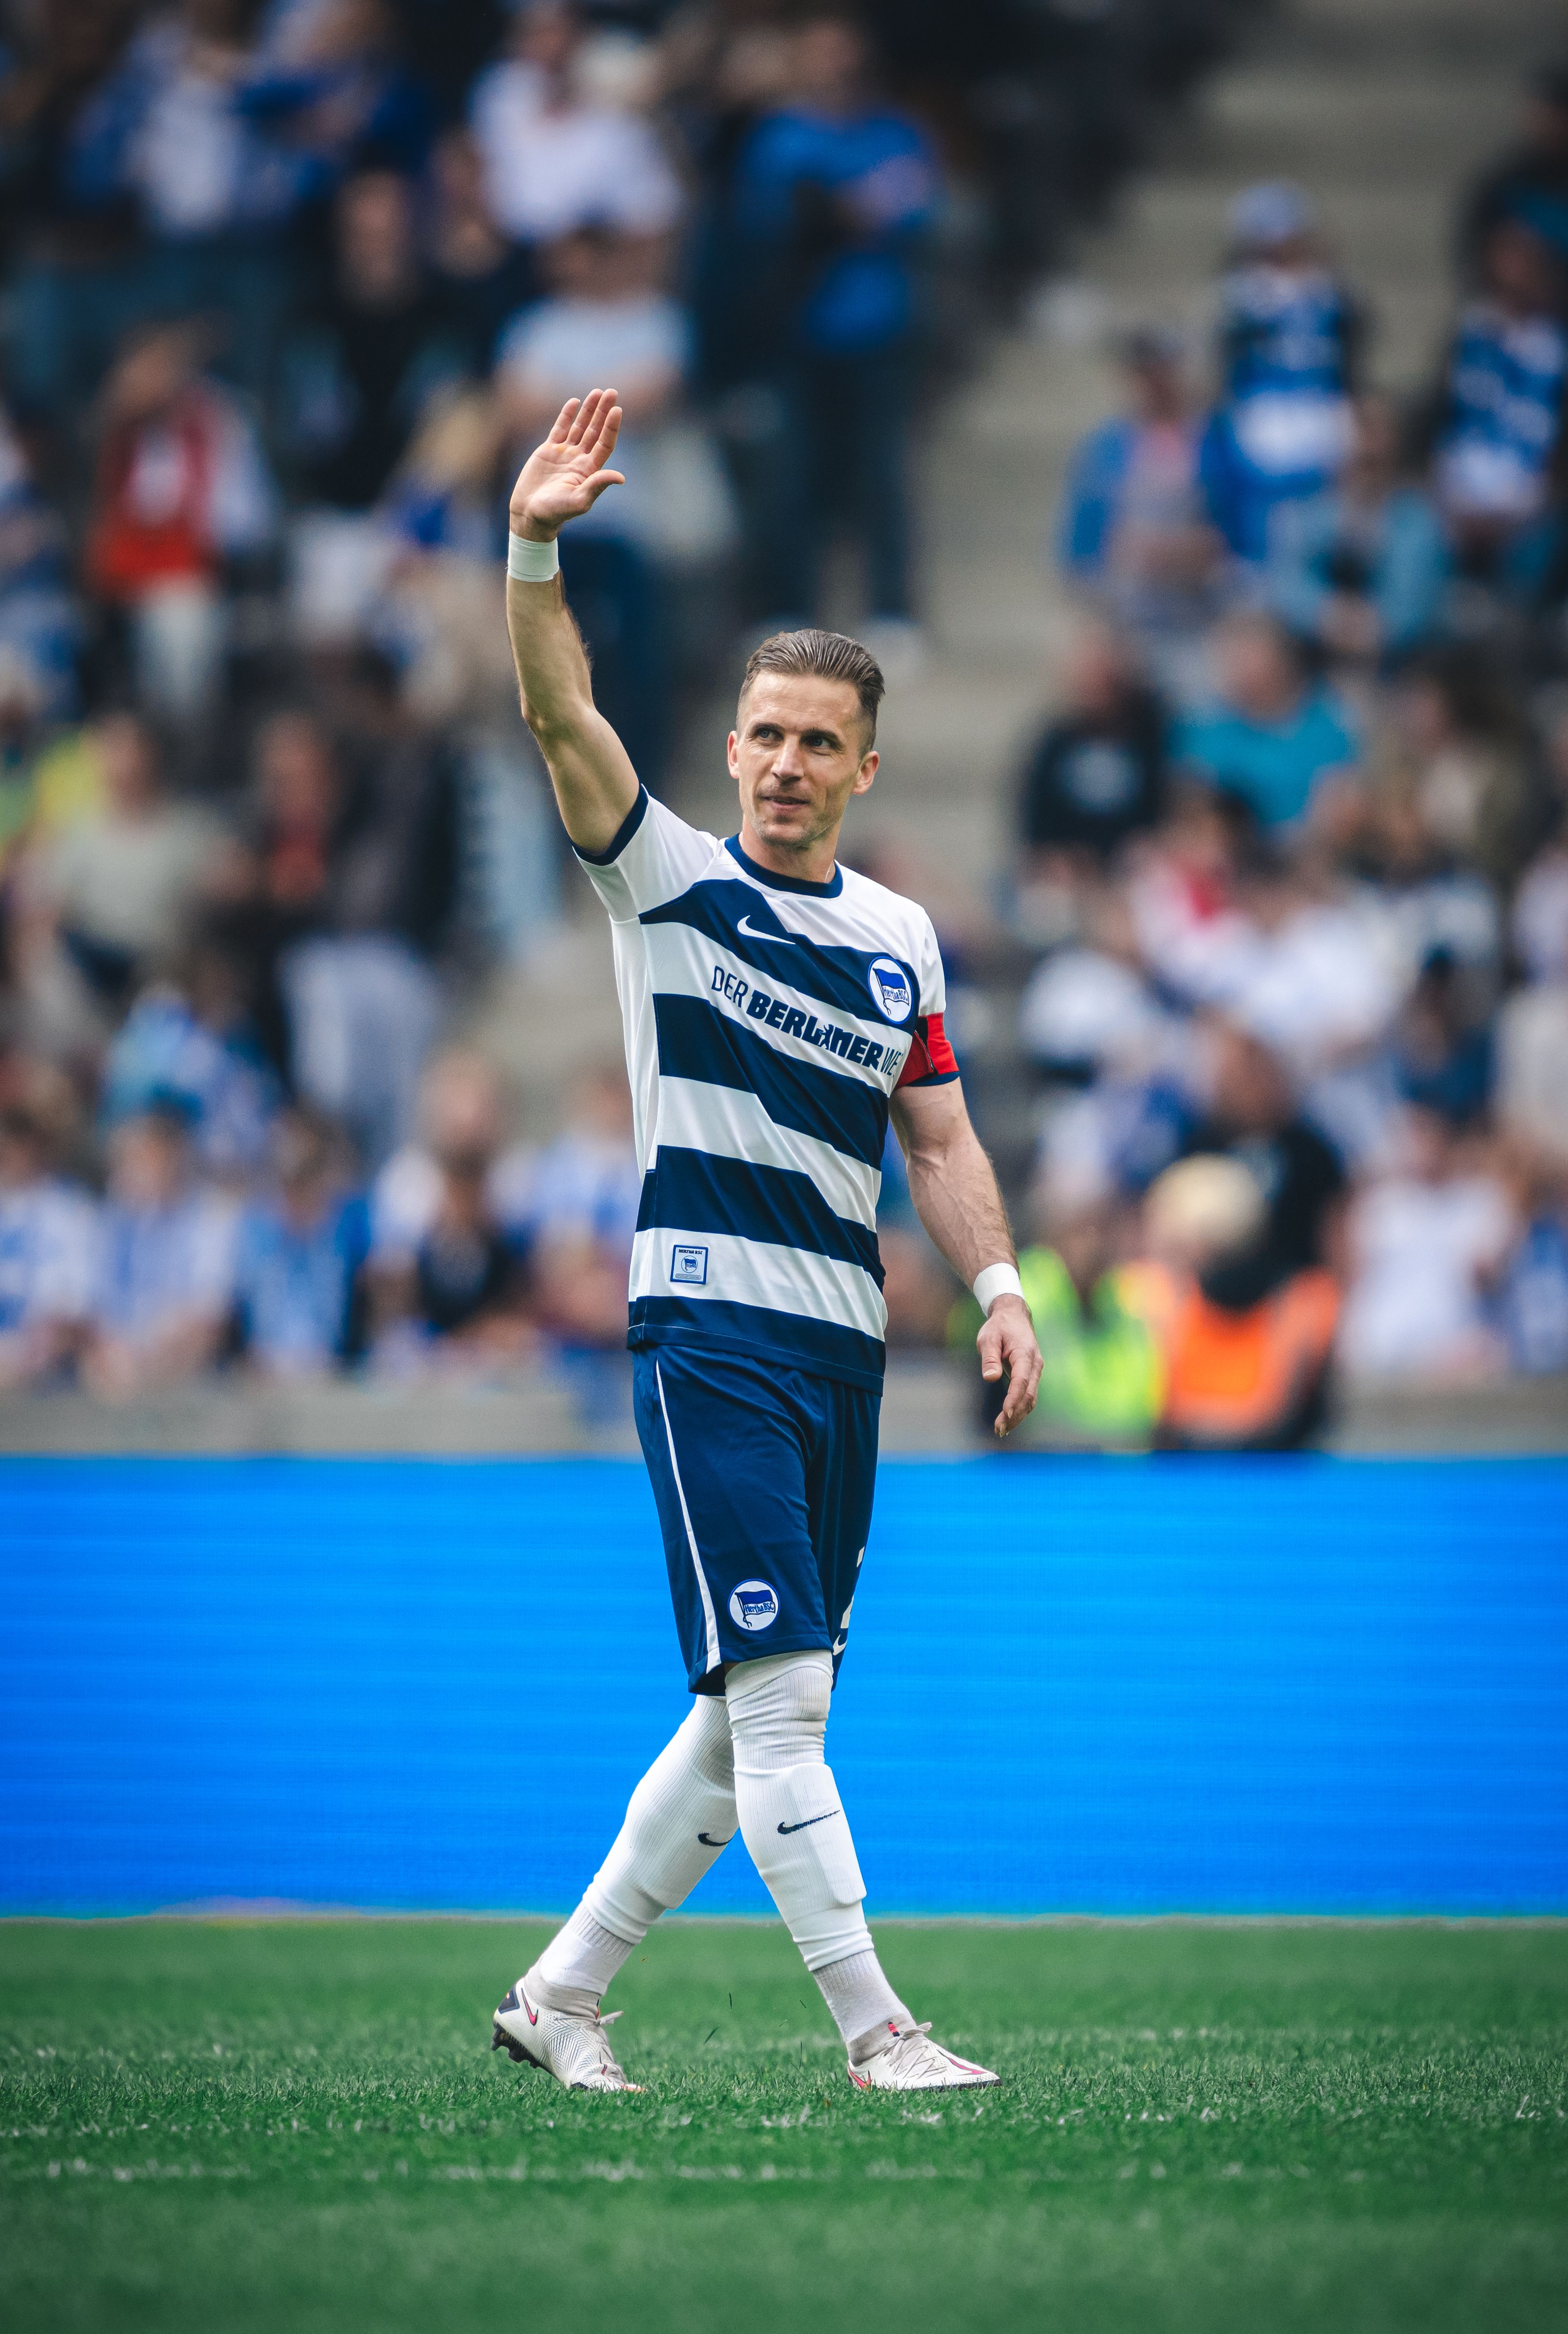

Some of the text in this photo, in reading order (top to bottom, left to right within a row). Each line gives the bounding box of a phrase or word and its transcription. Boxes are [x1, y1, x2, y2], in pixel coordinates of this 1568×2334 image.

[712, 965, 748, 1008] DER
[883, 987, 908, 1001] Hertha BSC
[745, 1602, 774, 1613] Hertha BSC
